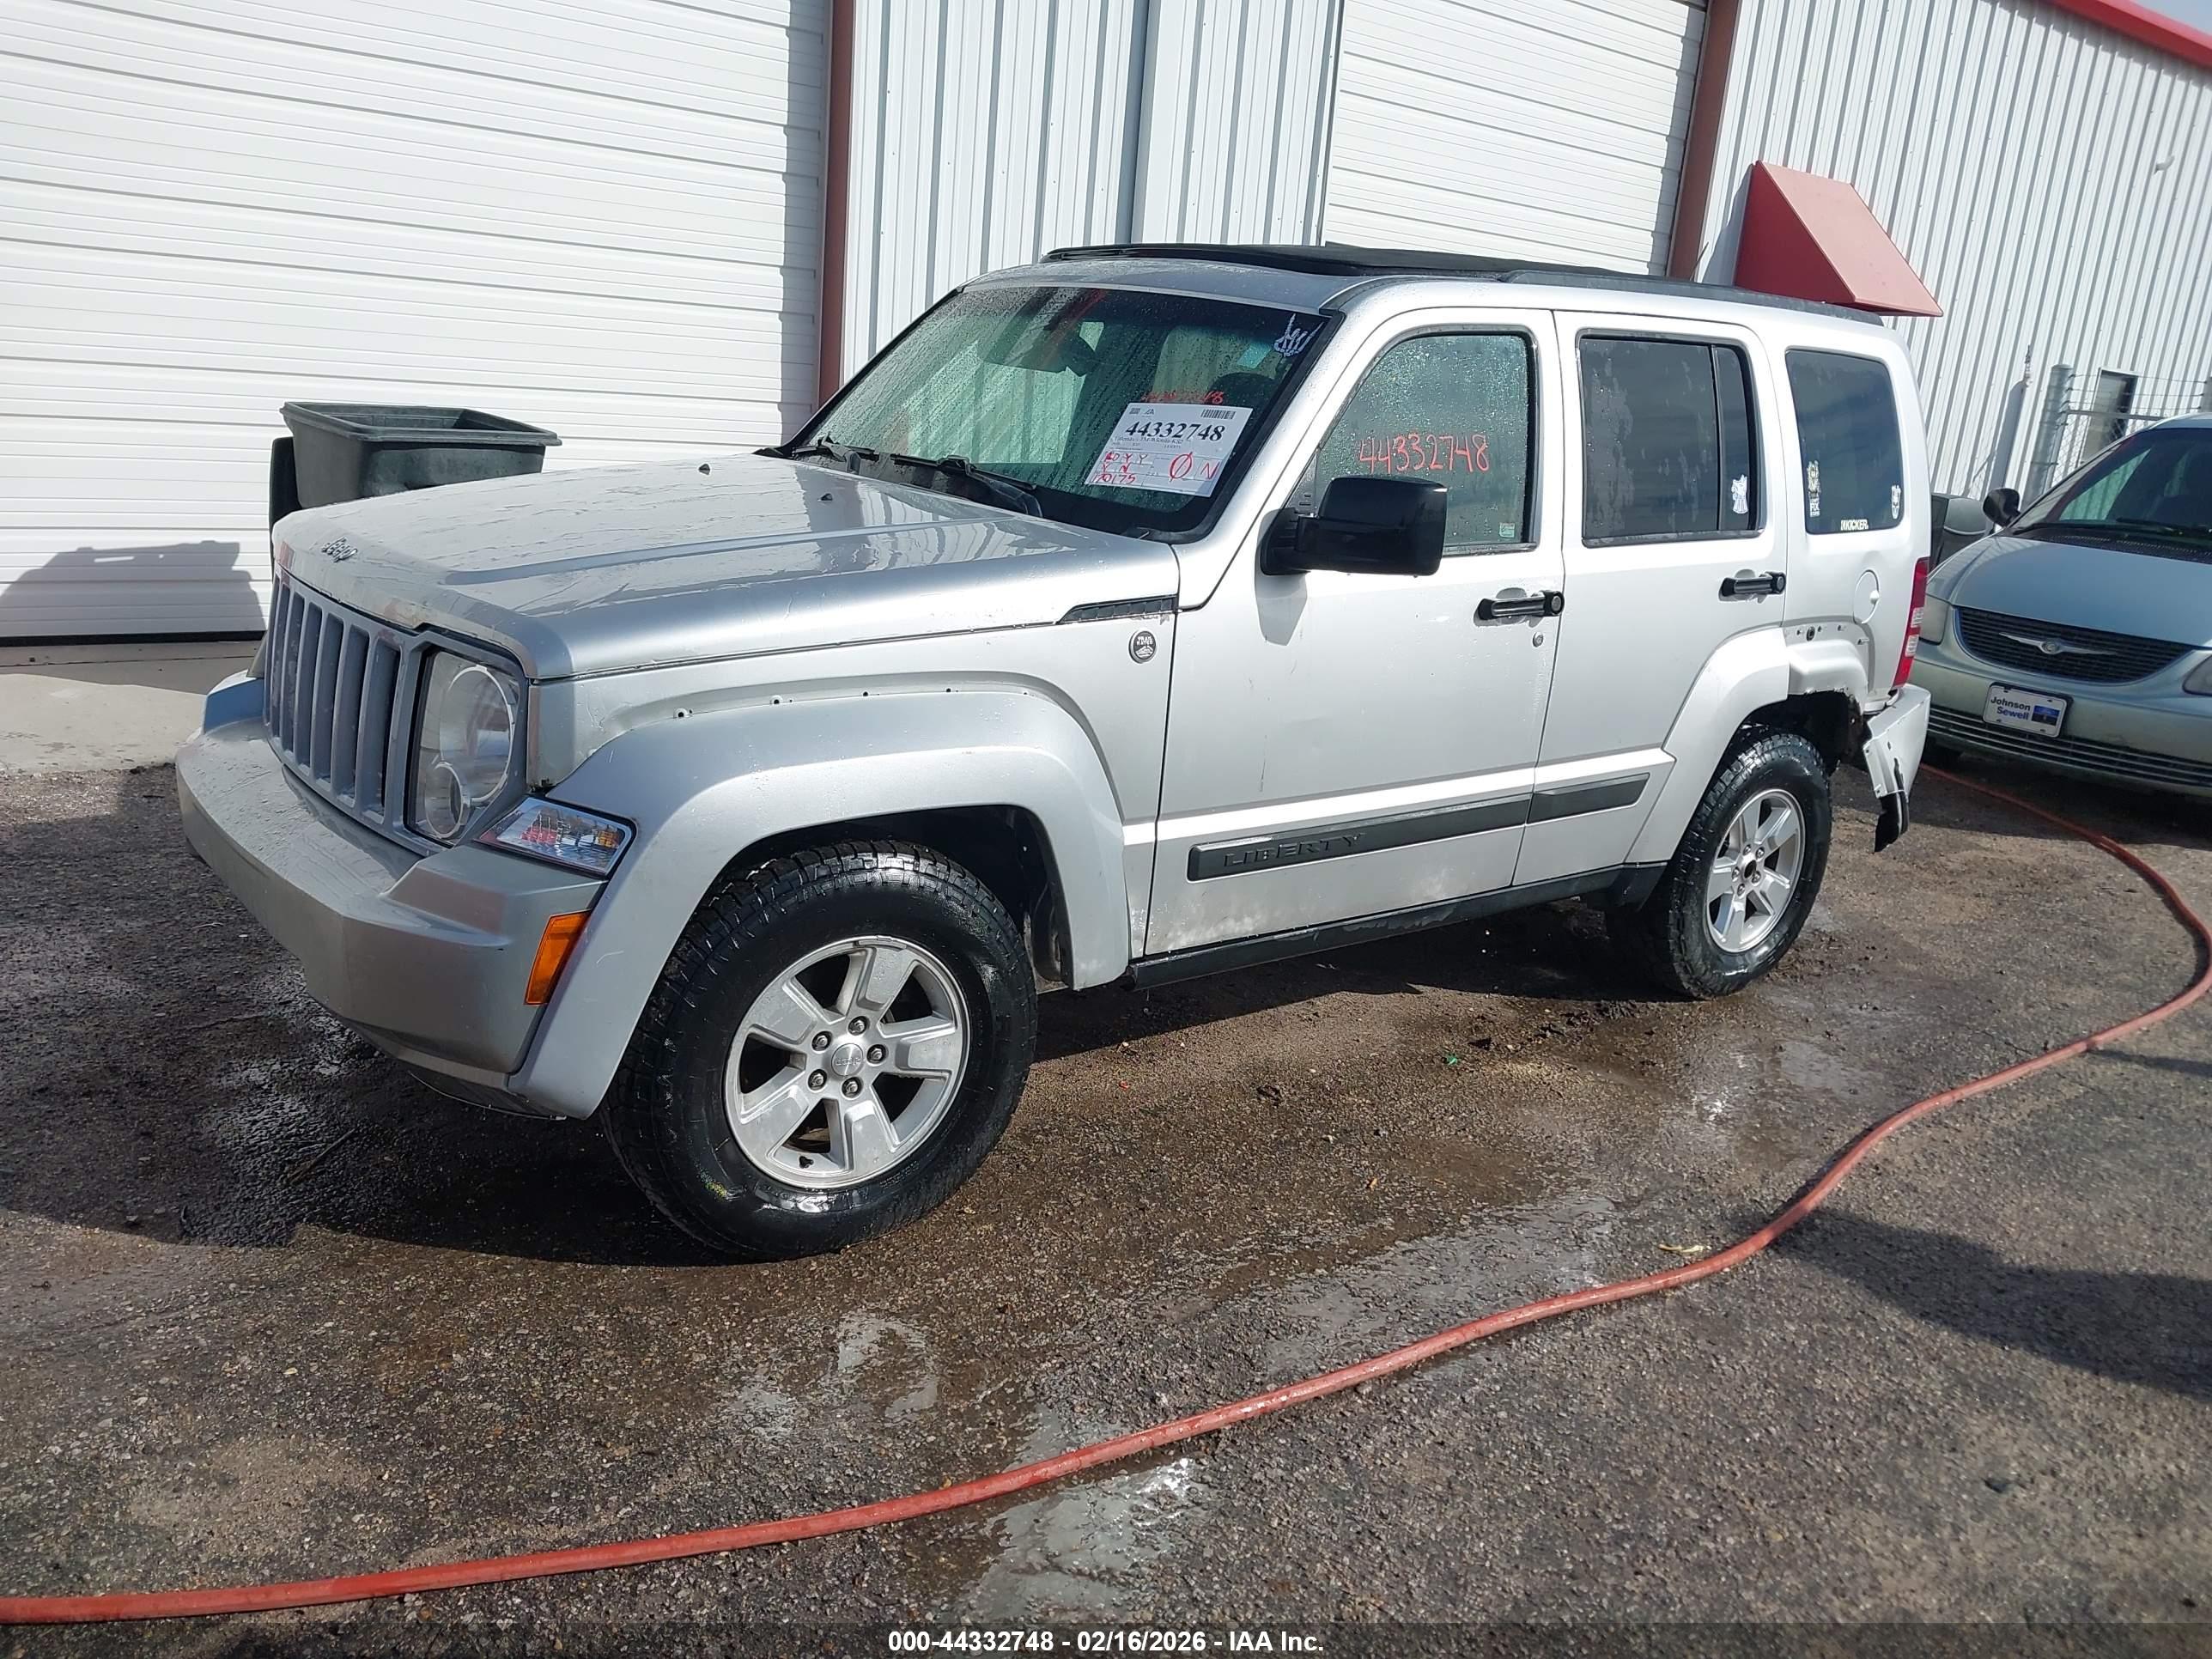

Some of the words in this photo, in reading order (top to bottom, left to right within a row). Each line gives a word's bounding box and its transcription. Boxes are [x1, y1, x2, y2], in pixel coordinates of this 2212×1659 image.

[1126, 421, 1225, 441] 44332748
[1359, 434, 1490, 473] 44332748
[1200, 461, 1219, 479] N
[321, 536, 358, 563] Jeep
[1990, 696, 2031, 711] Johnson
[1996, 706, 2029, 720] Sewell
[1224, 832, 1367, 867] LIBERTY
